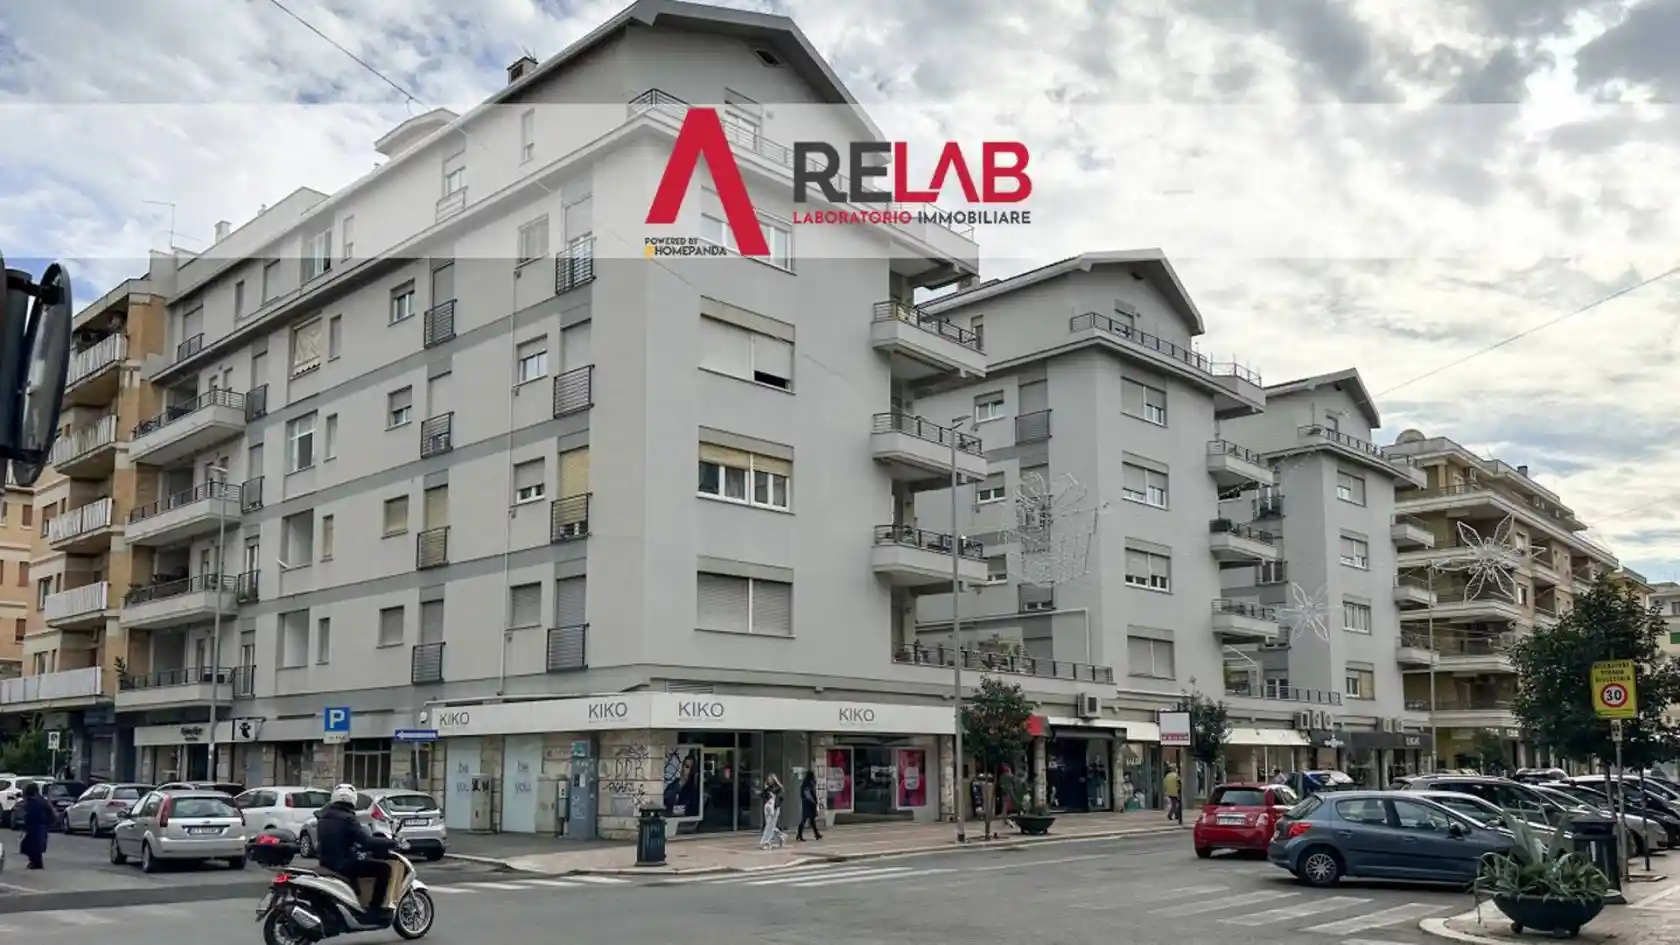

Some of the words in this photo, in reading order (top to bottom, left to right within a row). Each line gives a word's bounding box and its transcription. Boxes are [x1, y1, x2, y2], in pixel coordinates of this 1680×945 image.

[1606, 689, 1622, 702] 30
[588, 702, 628, 719] KIKO
[678, 701, 725, 718] KIKO
[838, 708, 875, 722] KIKO
[329, 709, 345, 729] P
[439, 711, 470, 726] KIKO
